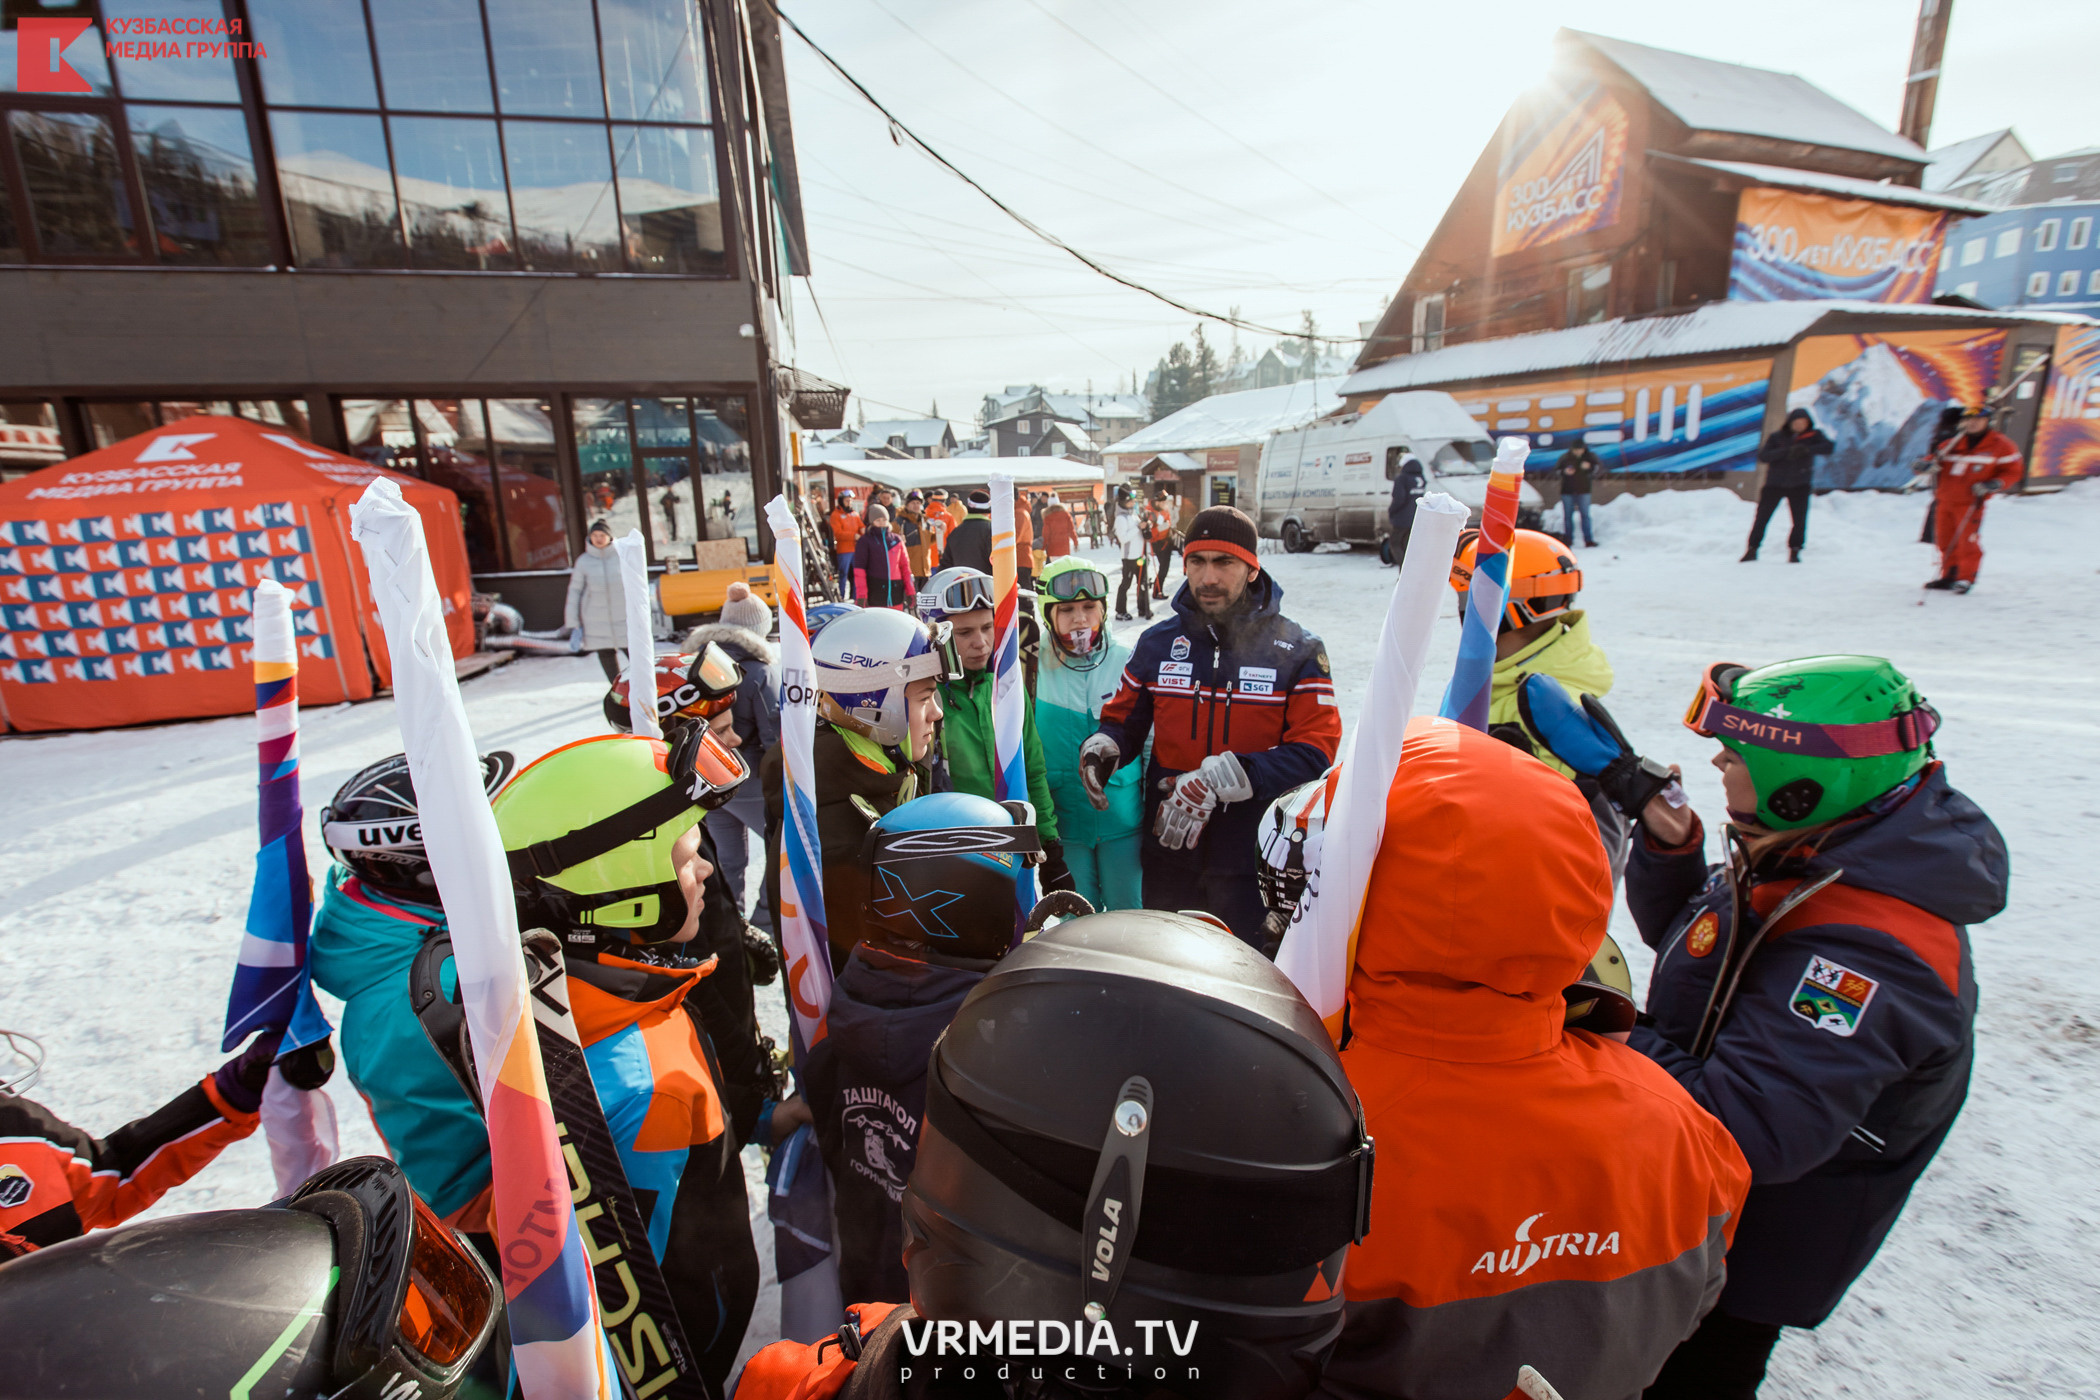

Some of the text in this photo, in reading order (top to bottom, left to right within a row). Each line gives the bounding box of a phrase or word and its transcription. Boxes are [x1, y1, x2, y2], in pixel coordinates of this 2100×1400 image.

[1506, 184, 1604, 234] КУЗБАСС
[1509, 176, 1549, 209] 300
[1747, 223, 1798, 262] 300
[1831, 234, 1935, 273] КУЗБАСС
[26, 475, 244, 500] МЕДИА ГРУППА
[60, 462, 243, 485] КУЗБАССКАЯ
[657, 683, 700, 717] OC
[1253, 684, 1269, 692] SGT
[1722, 714, 1802, 745] SMITH
[358, 823, 424, 846] uve
[843, 1086, 917, 1136] ТАШТАГОЛ
[1092, 1198, 1123, 1282] VOLA
[1470, 1212, 1620, 1276] AUSTRIA
